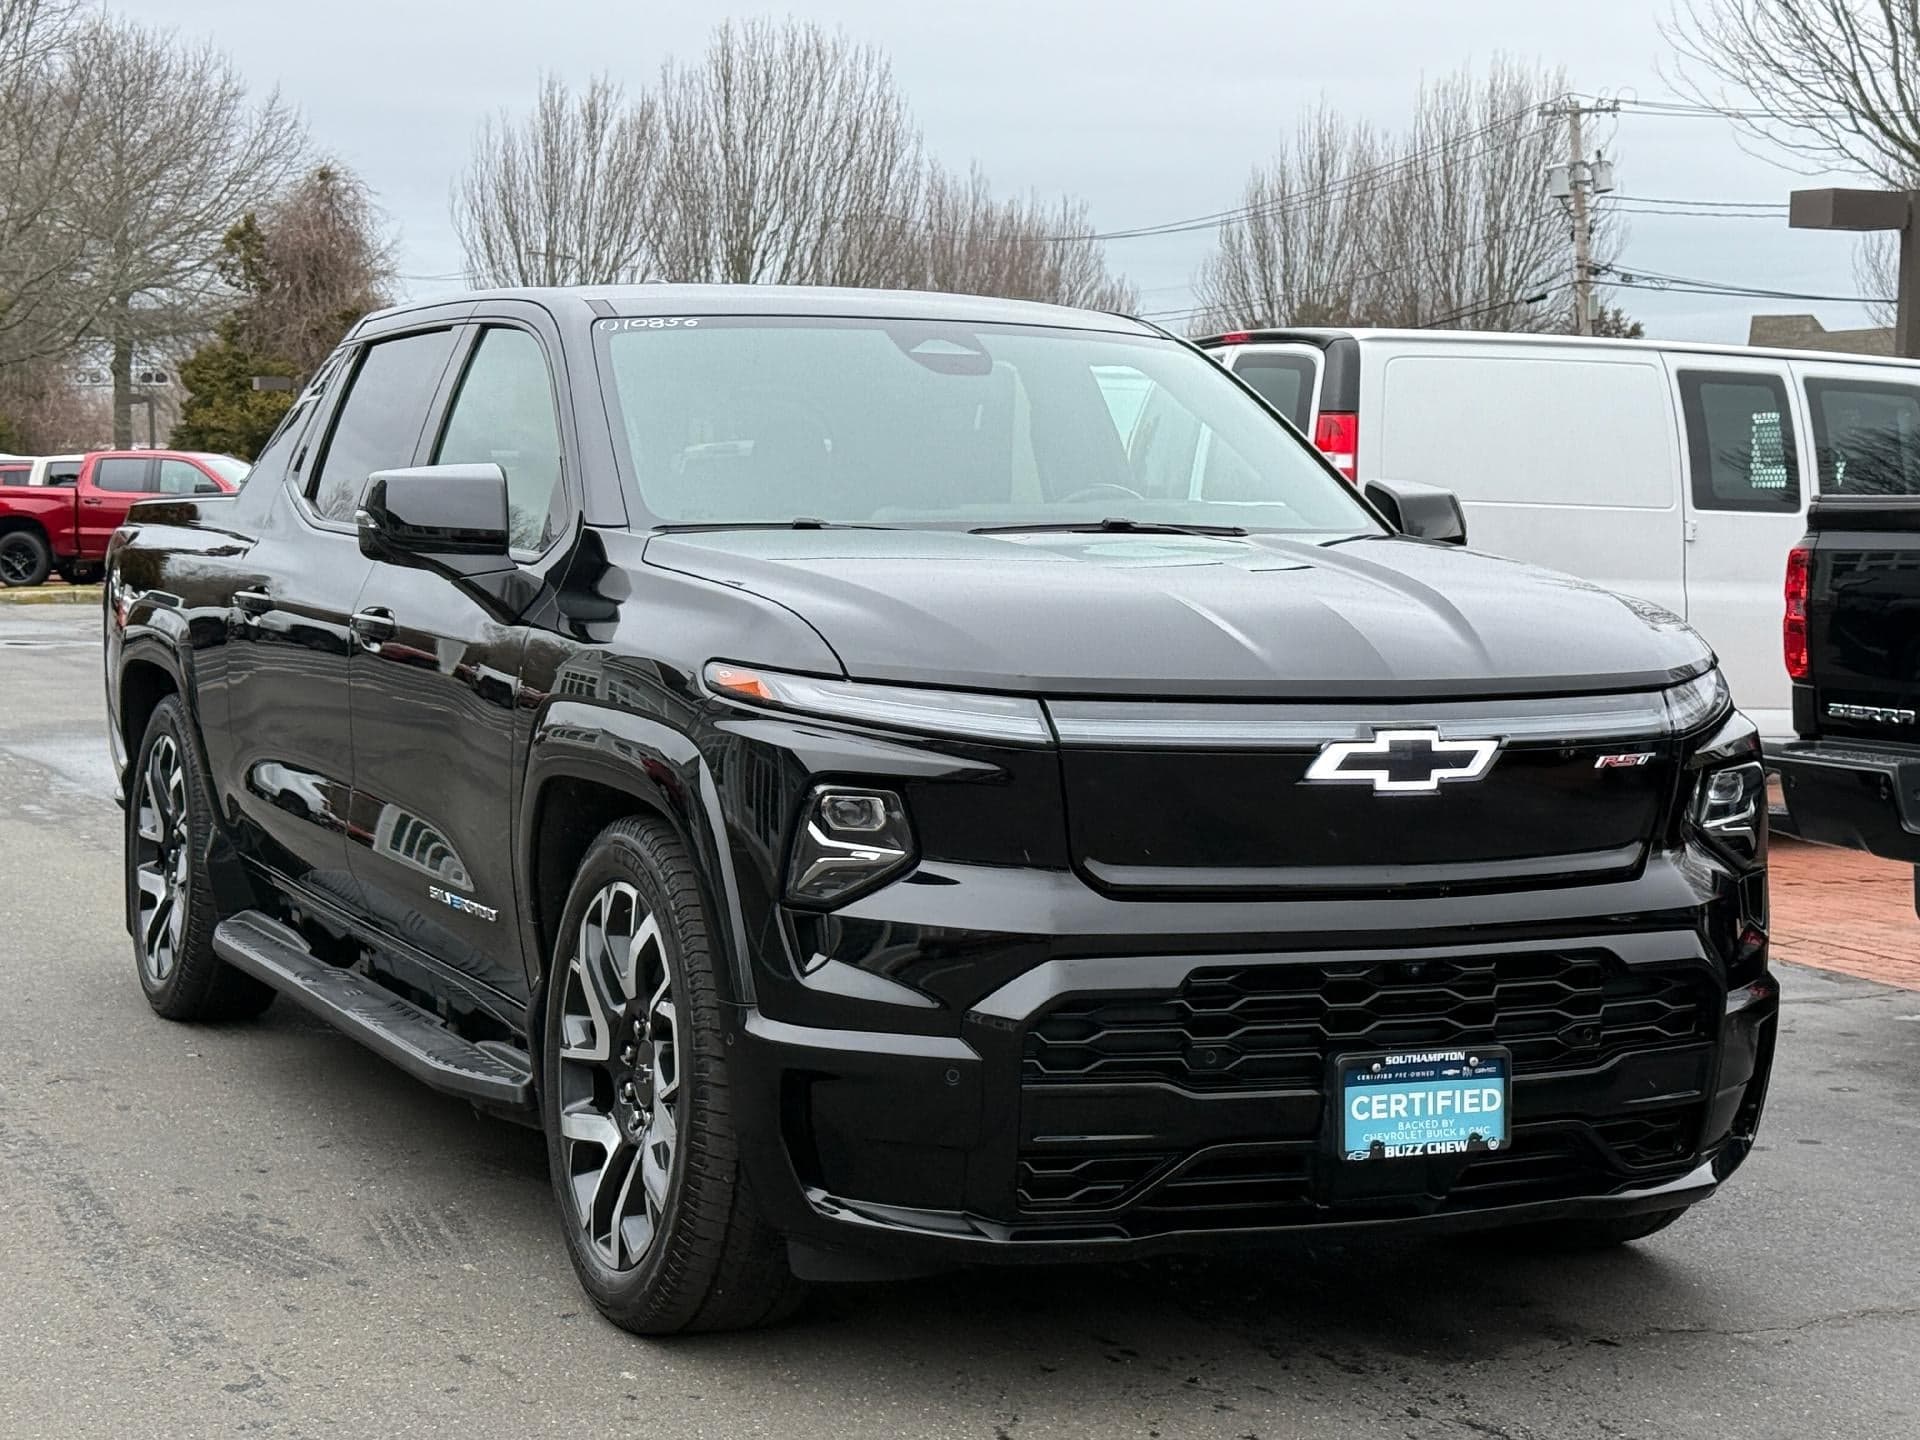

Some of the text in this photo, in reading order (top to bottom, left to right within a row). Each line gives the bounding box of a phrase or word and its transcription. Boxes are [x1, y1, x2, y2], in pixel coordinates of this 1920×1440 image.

[1828, 703, 1915, 724] SIERRA
[1594, 752, 1656, 769] RST
[429, 885, 499, 922] SILVERADO
[1385, 1051, 1466, 1065] SOUTHAMPTON
[1357, 1070, 1435, 1081] CERTIFIED PRE-OWNED
[1351, 1088, 1502, 1121] CERTIFIED
[1398, 1119, 1455, 1131] BACKED BY
[1363, 1129, 1423, 1142] CHEVROLET
[1426, 1129, 1457, 1138] BUICK
[1459, 1128, 1466, 1136] &
[1384, 1140, 1469, 1158] BUZZ CHEW
